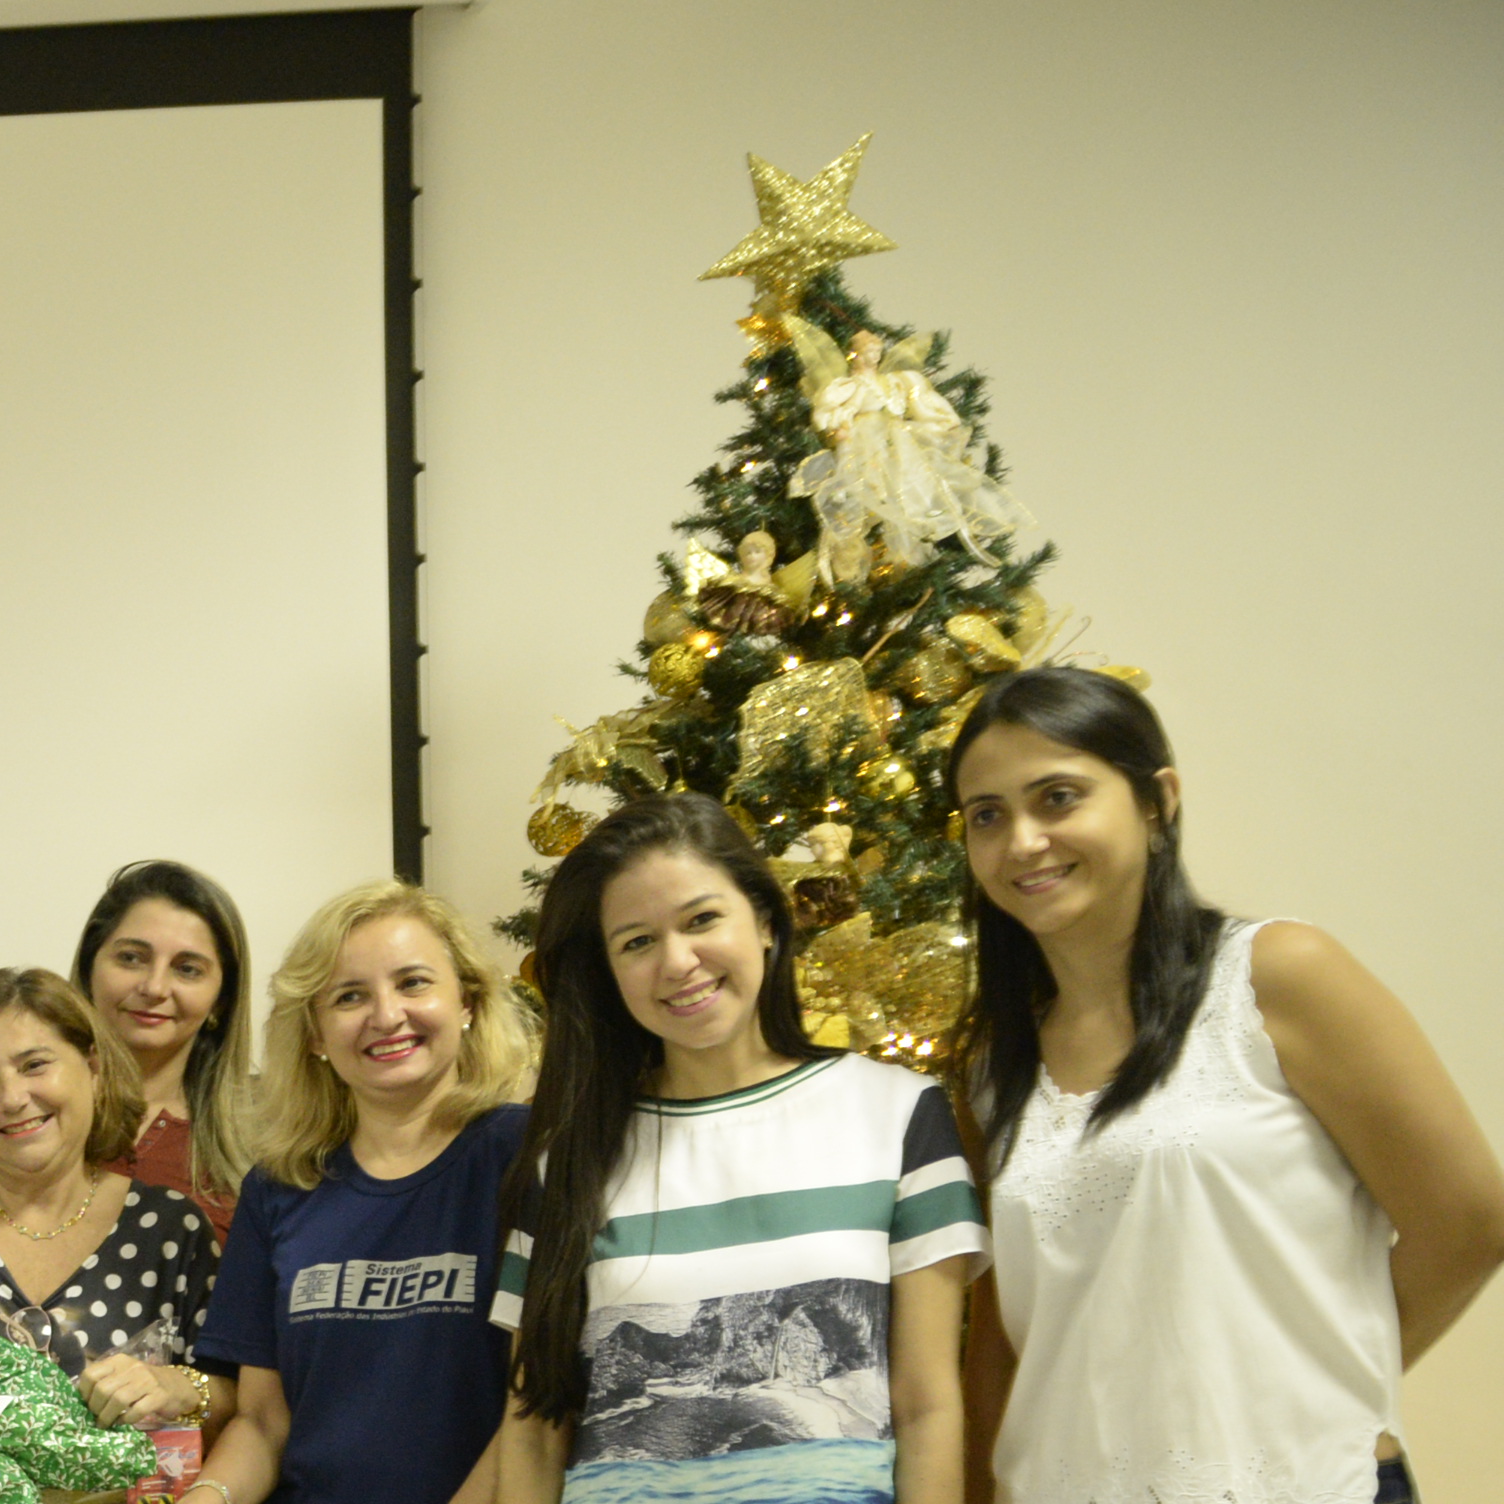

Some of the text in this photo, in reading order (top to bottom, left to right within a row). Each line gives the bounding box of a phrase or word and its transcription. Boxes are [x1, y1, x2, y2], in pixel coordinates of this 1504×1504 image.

[365, 1261, 423, 1276] Sistema
[357, 1268, 461, 1308] FIEPI
[315, 1310, 355, 1321] Federação
